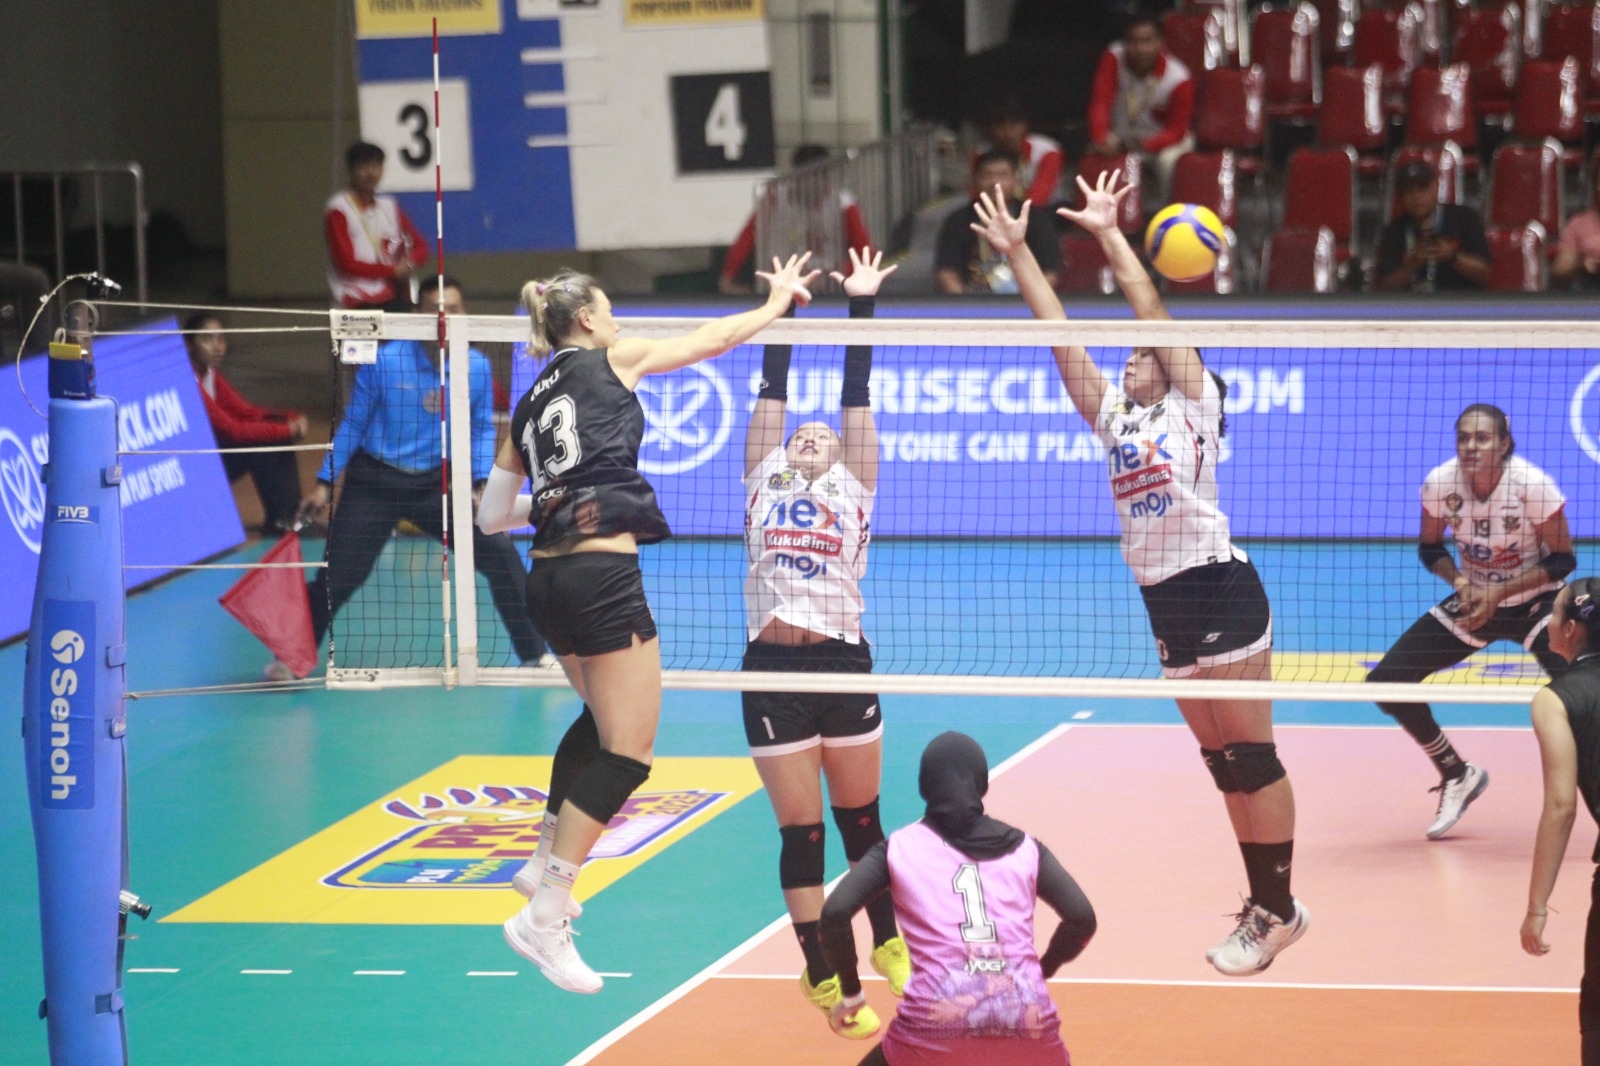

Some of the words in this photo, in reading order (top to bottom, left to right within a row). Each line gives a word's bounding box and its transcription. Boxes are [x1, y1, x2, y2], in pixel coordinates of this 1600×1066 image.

[399, 104, 433, 168] 3
[705, 83, 747, 161] 4
[522, 393, 581, 497] 13
[967, 432, 1030, 463] CAN
[1109, 433, 1173, 477] nex
[1115, 469, 1170, 497] KukuBima
[58, 506, 89, 519] FIVB
[762, 499, 843, 535] nex
[1131, 492, 1173, 519] moji
[767, 533, 838, 553] KukuBima
[1473, 518, 1491, 538] 19
[775, 553, 827, 580] moji
[51, 668, 78, 800] Senoh
[762, 716, 775, 740] 1
[952, 863, 998, 943] 1
